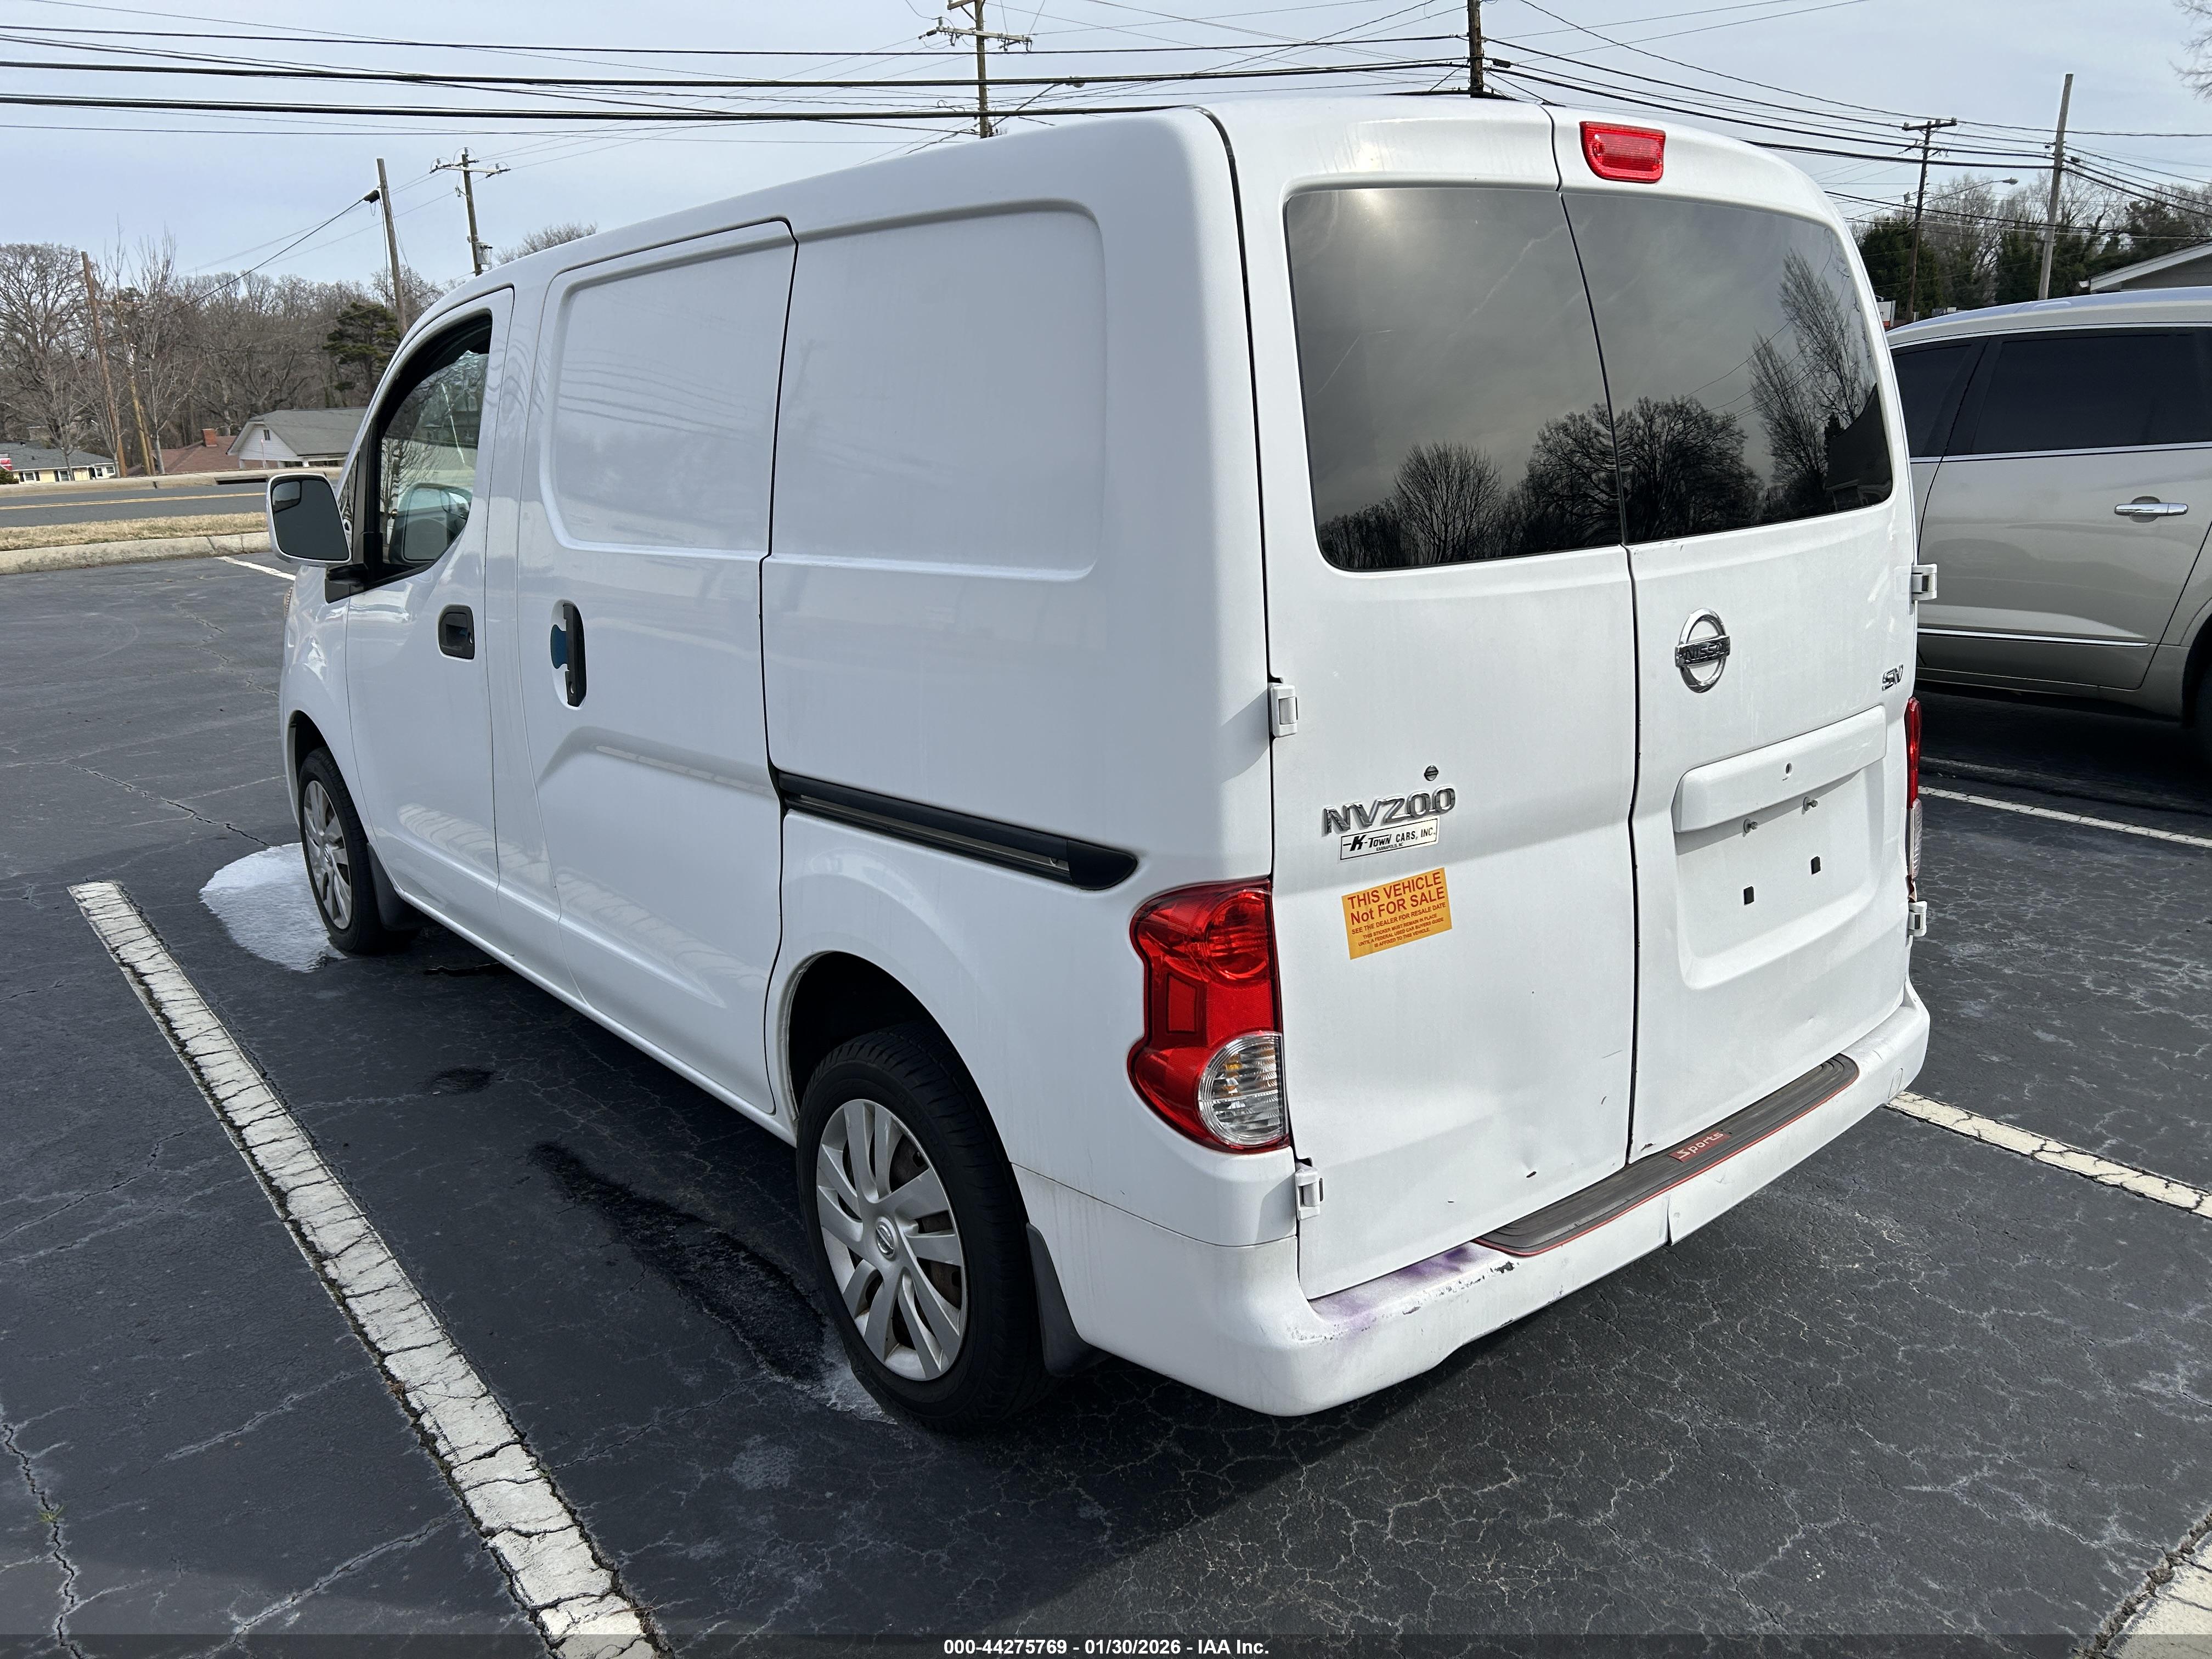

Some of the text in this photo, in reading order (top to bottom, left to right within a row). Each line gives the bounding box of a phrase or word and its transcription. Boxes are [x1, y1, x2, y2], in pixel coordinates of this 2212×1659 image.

[1882, 664, 1904, 691] SV
[1323, 786, 1456, 836] NV200
[1396, 831, 1419, 843] CARS,
[1421, 827, 1437, 838] INC.
[1347, 871, 1442, 909] THIS VEHICLE
[1350, 886, 1445, 925] Not FOR SALE
[1351, 927, 1363, 935] SEE
[1375, 916, 1398, 927] DEALER
[1398, 913, 1410, 921] FOR
[1410, 906, 1432, 917] RESALE
[1432, 902, 1446, 911] DATE
[1373, 927, 1391, 936] STICKER
[1677, 1132, 1724, 1159] Sports
